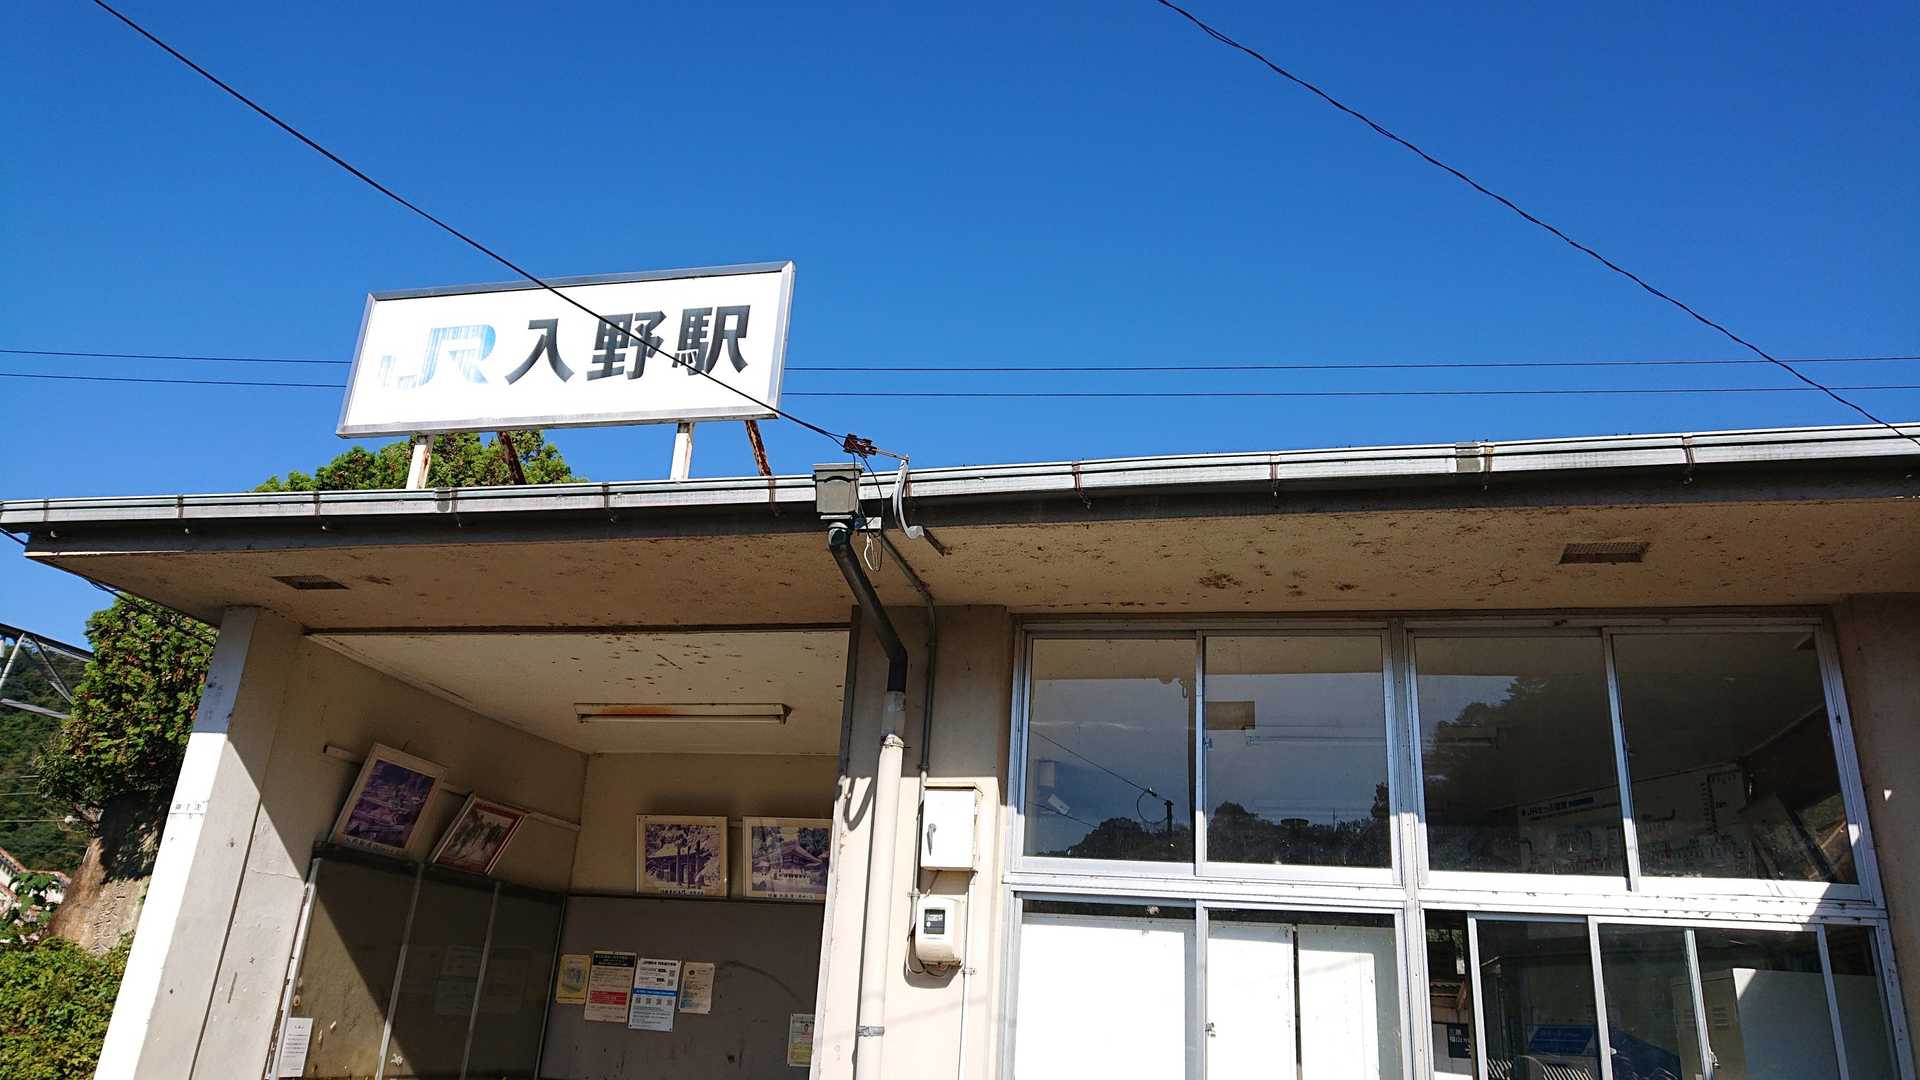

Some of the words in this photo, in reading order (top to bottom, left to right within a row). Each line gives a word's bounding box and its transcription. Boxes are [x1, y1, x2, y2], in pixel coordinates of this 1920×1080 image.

[378, 324, 497, 389] JR
[504, 305, 751, 386] 入野駅
